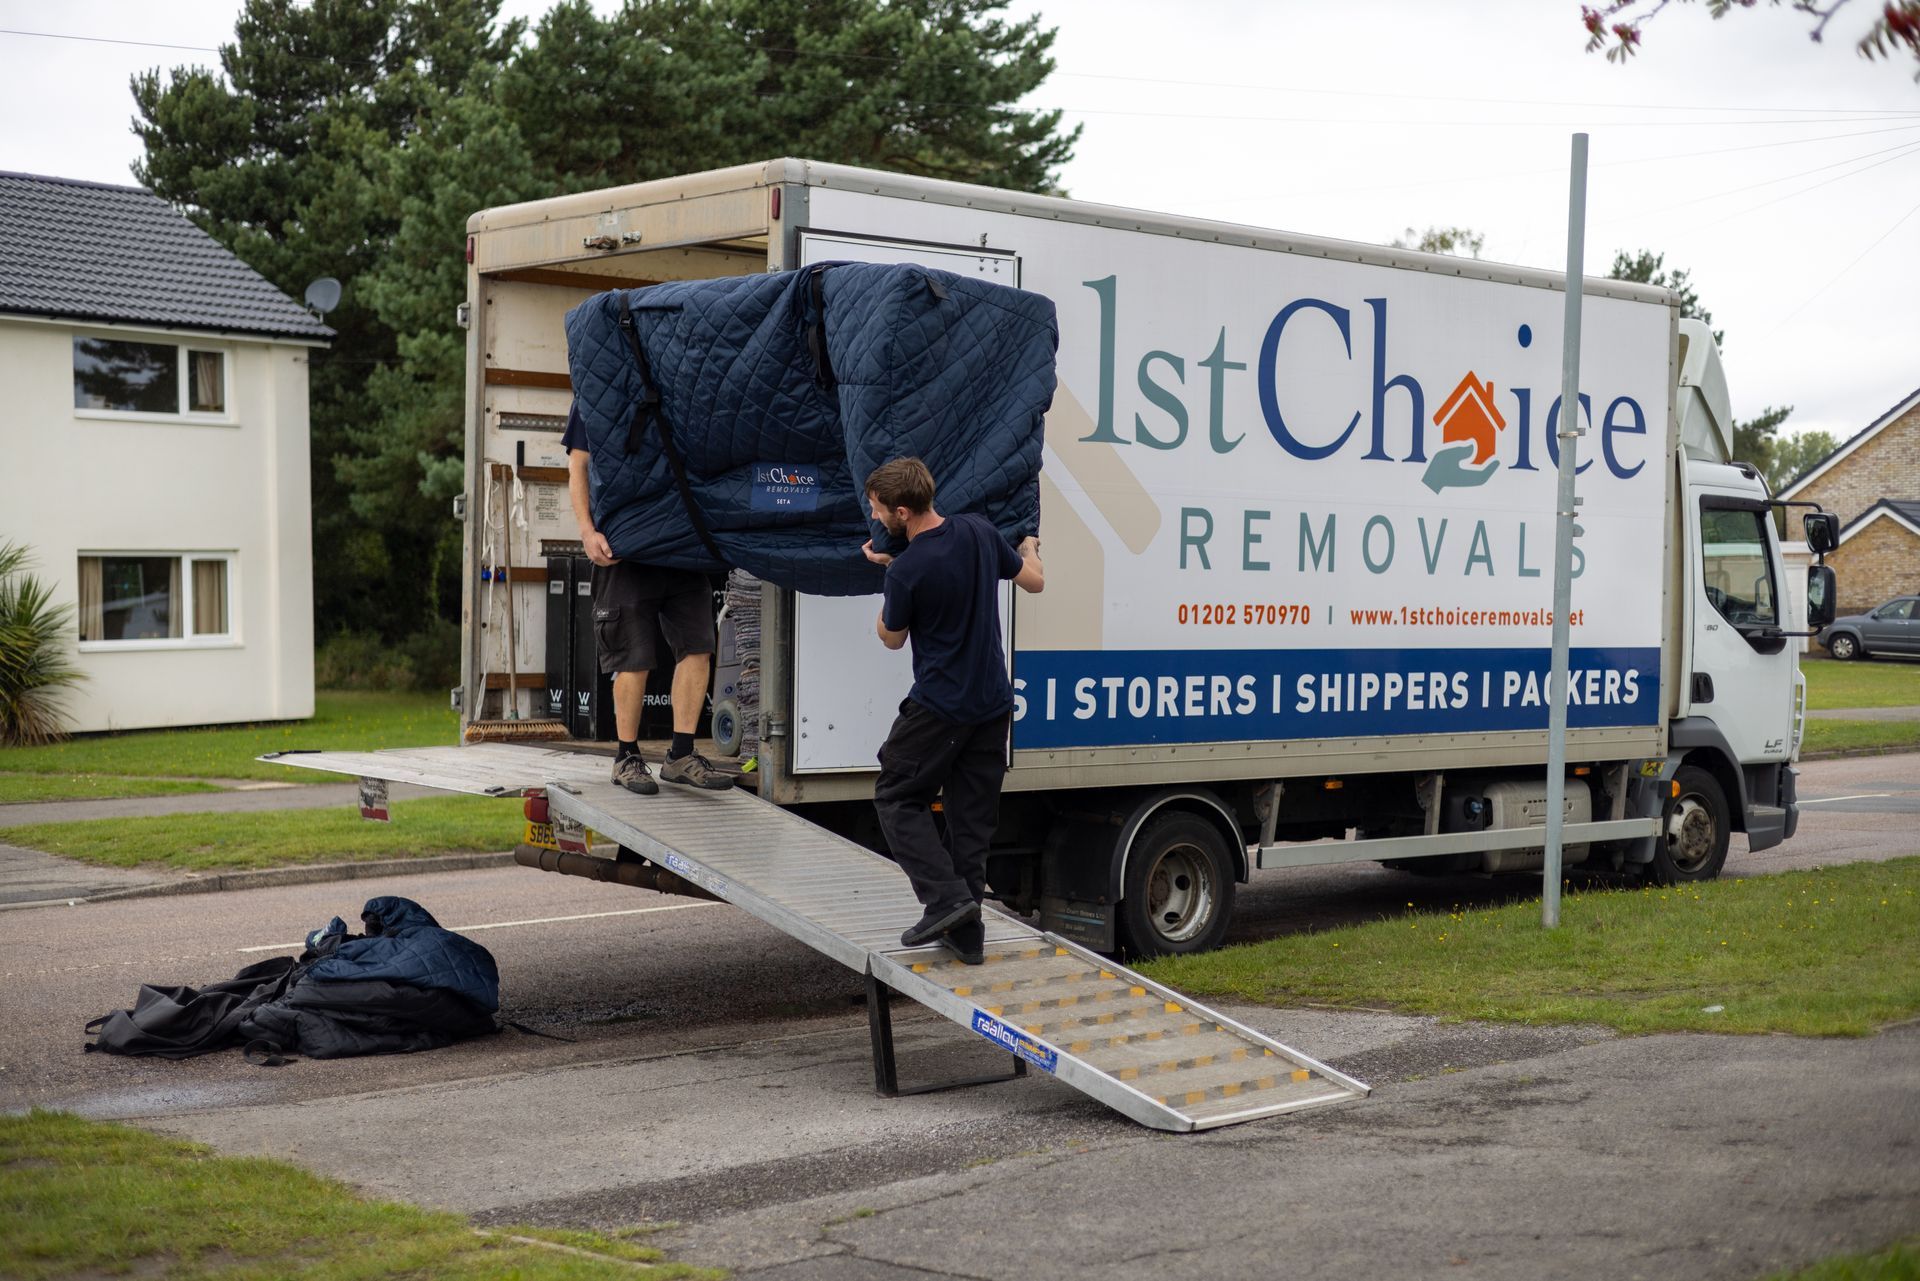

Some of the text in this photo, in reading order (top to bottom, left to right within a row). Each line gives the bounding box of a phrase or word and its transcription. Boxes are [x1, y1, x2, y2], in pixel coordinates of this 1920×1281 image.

[766, 486, 810, 494] REMOVALS
[1178, 604, 1236, 625] 01202
[1243, 605, 1310, 625] 570970
[1350, 606, 1584, 626] www.1stchoiceremovalset
[642, 694, 674, 706] FRAGI
[1073, 674, 1257, 720] STORERS
[1295, 670, 1469, 714] SHIPPERS
